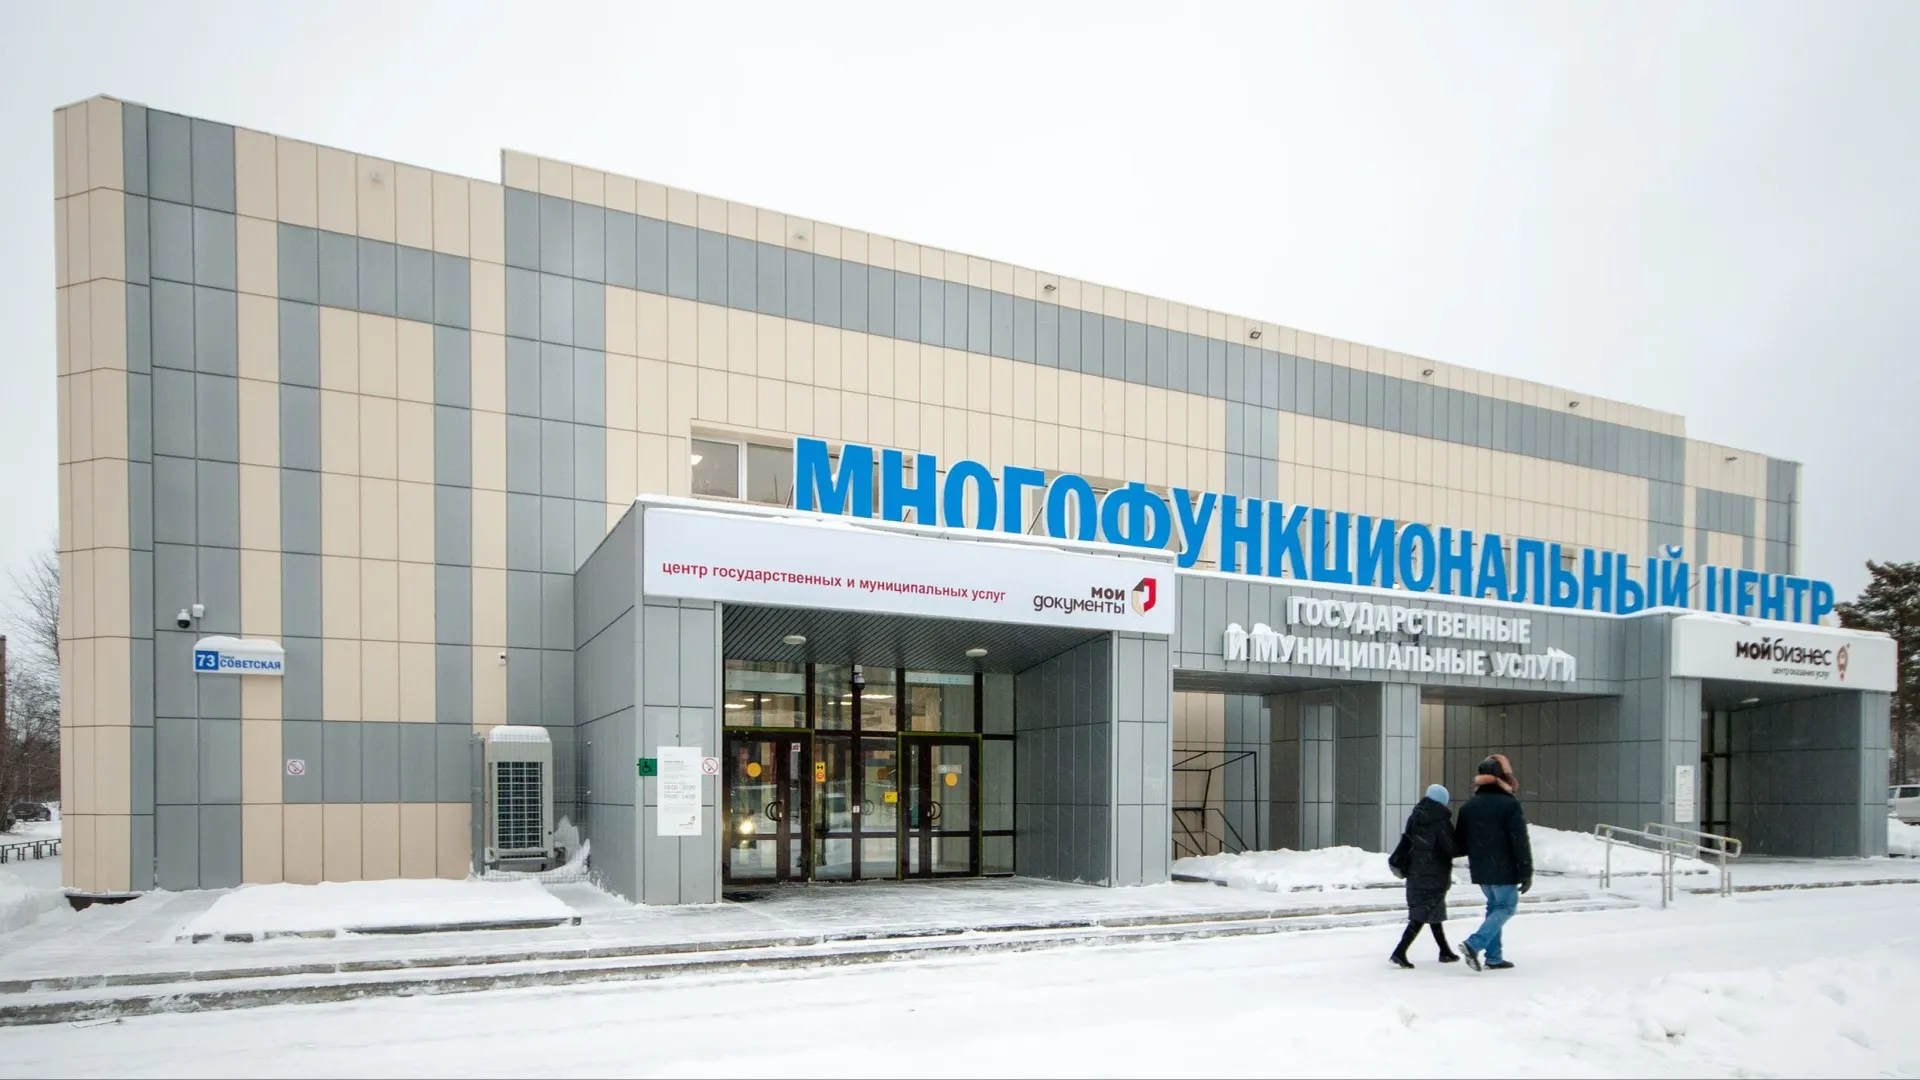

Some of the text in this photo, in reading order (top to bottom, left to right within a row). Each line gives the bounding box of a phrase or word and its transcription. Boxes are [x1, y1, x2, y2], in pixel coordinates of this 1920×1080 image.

[794, 436, 1690, 616] МНОГОФУНКЦИОНАЛЬНЫЙ
[662, 562, 1006, 603] центр государственных и муниципальных услуг
[1091, 586, 1125, 601] мои
[1033, 595, 1125, 614] документы
[1286, 596, 1531, 644] ГОСУДАРСТВЕННЫЕ
[197, 654, 216, 667] 73
[220, 659, 281, 670] СОВЕТСКАЯ
[1250, 631, 1487, 677] МУНИЦИПАЛЬНЫЕ
[1490, 650, 1577, 682] УСЛУГИ
